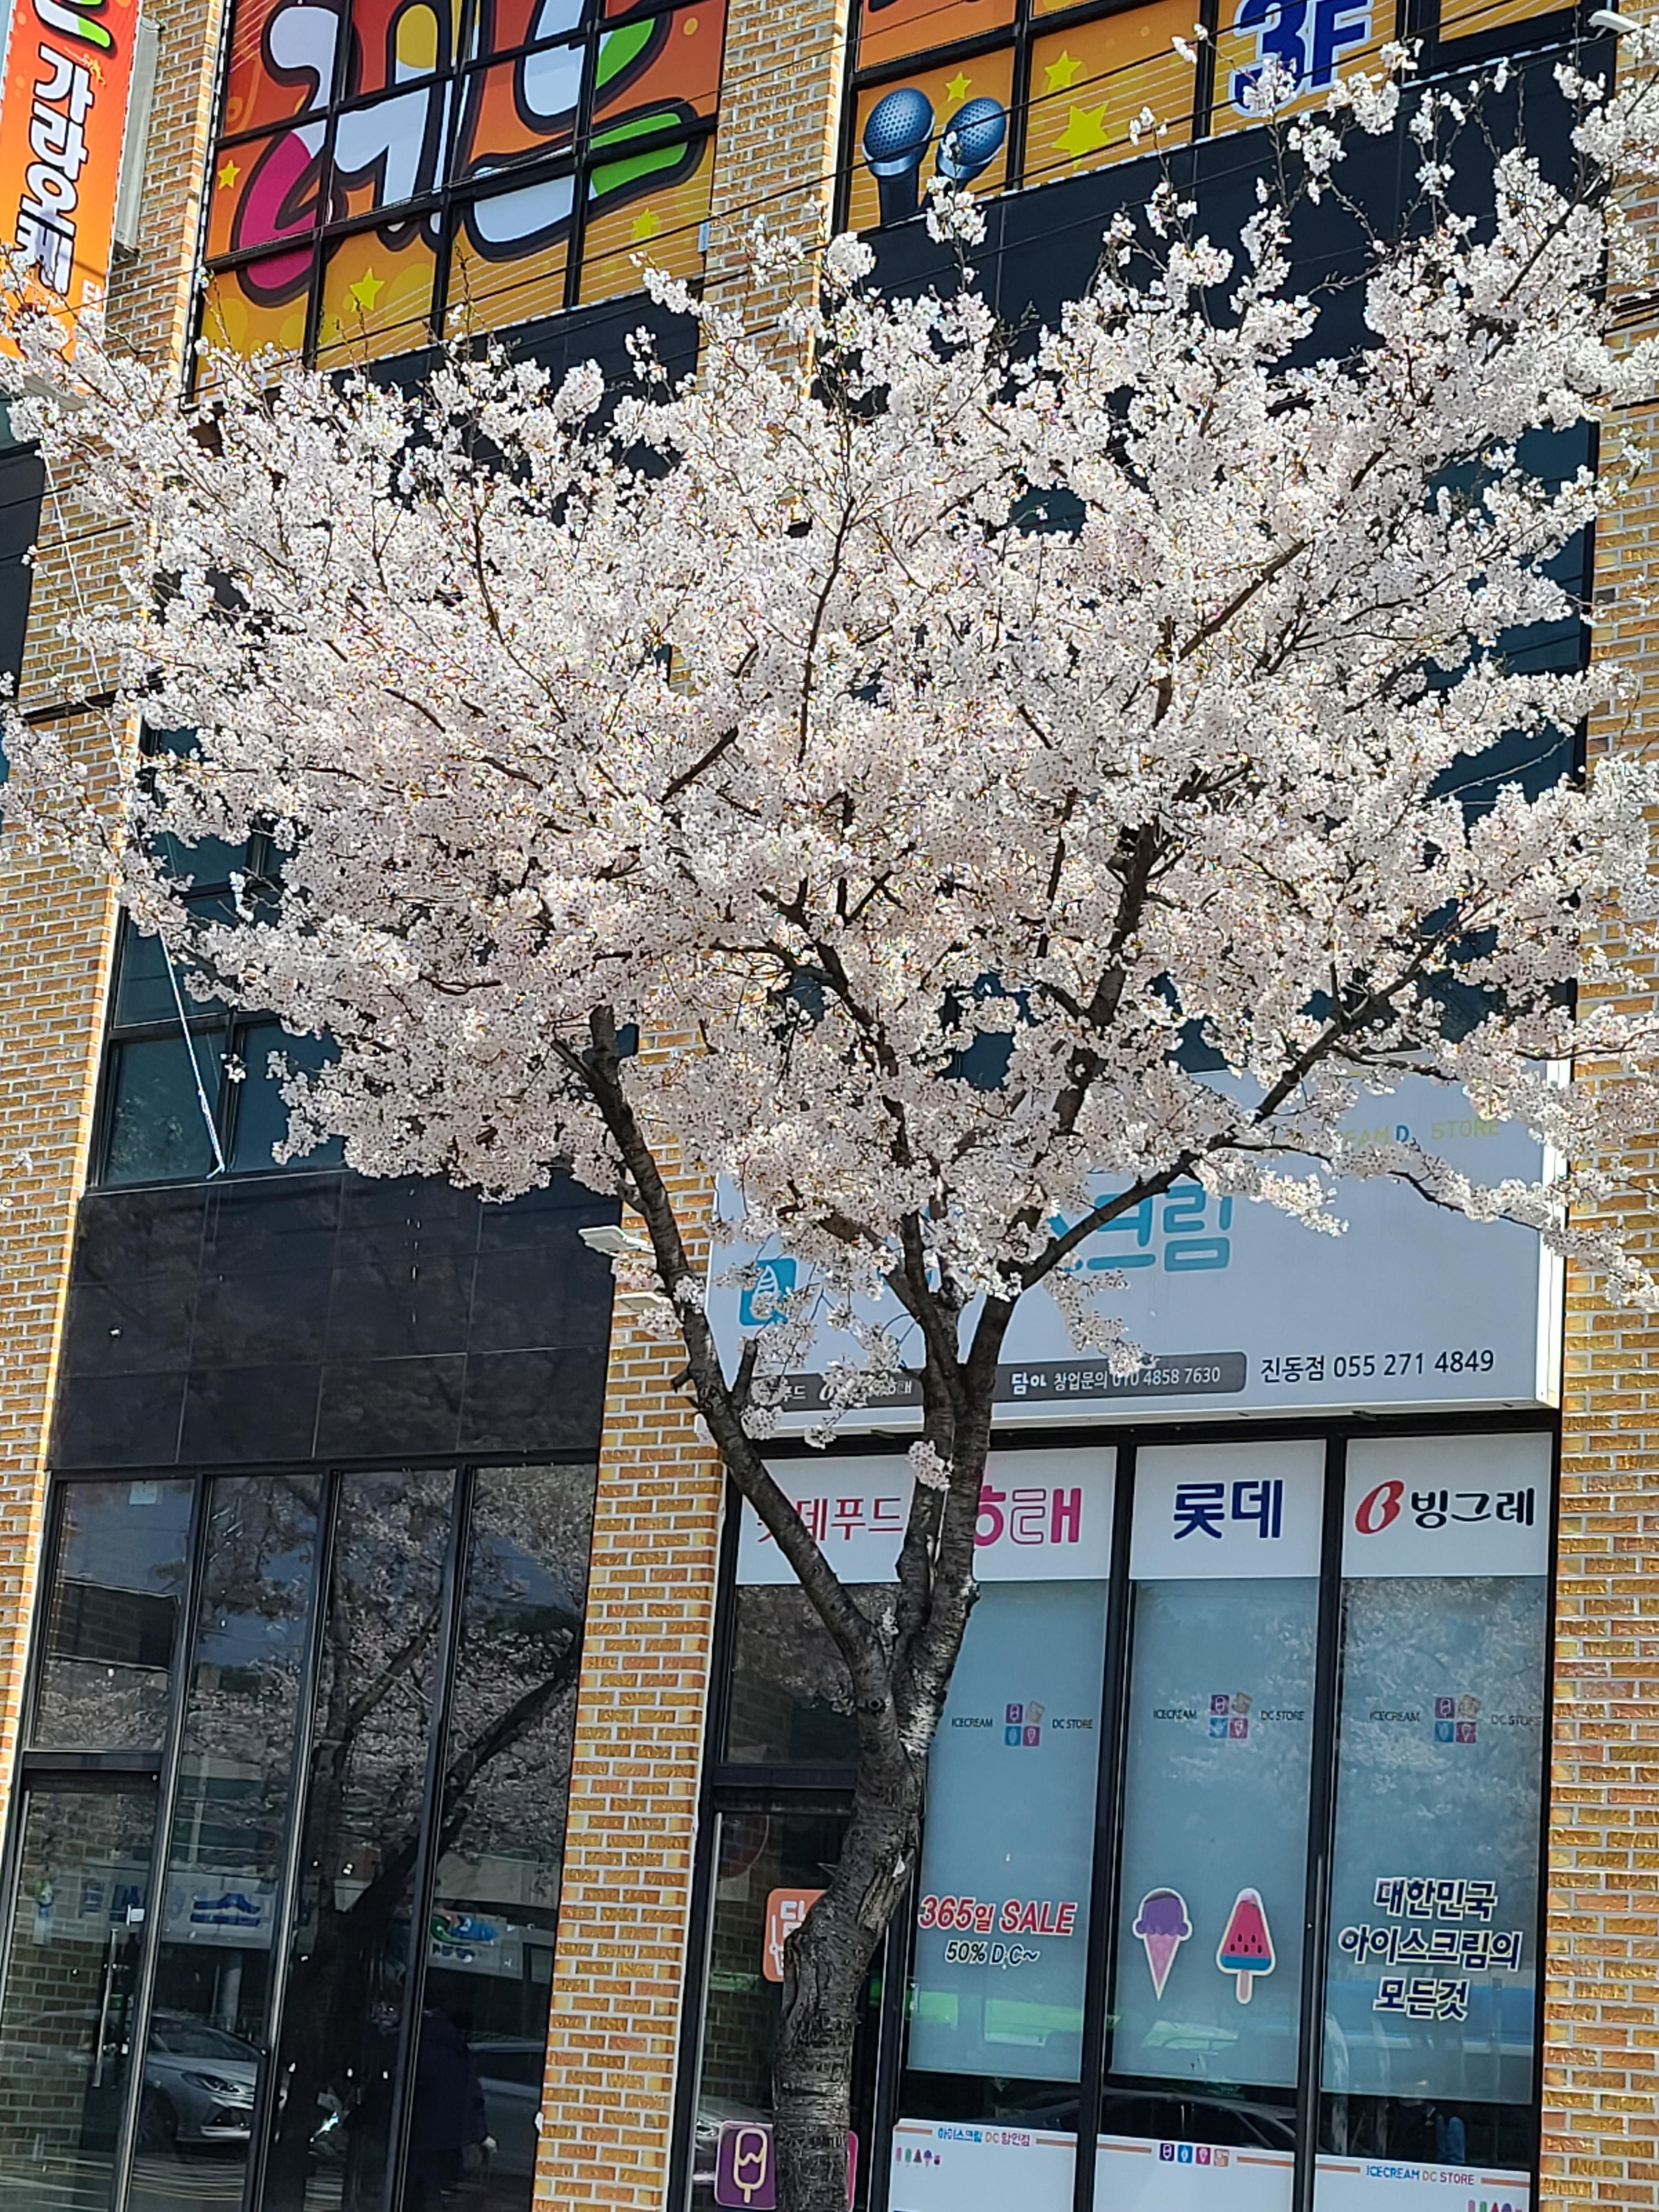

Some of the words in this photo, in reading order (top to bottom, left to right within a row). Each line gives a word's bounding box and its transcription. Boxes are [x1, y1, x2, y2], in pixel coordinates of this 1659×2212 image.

[1229, 0, 1373, 115] 3F
[14, 43, 94, 296] 가라오케
[1431, 1117, 1500, 1140] STORE
[1053, 1370, 1108, 1392] 창업문의
[1142, 1368, 1180, 1386] 4858
[1184, 1366, 1222, 1384] 7630
[1260, 1354, 1325, 1383] 진동점
[1333, 1354, 1376, 1378] 055
[1383, 1353, 1423, 1376] 271
[1434, 1349, 1494, 1373] 4849
[756, 1498, 904, 1543] 데푸드
[1173, 1480, 1284, 1540] 롯데
[1411, 1488, 1535, 1529] 빙그레
[918, 1895, 996, 1934] 365일
[999, 1898, 1078, 1936] SALE
[1374, 1878, 1497, 1921] 대한민국
[945, 1939, 987, 1964] 50%
[1339, 1924, 1523, 1971] 아이스크림의
[1373, 1976, 1469, 2021] 모든것
[937, 2127, 982, 2143] 아이스크림
[1366, 2164, 1420, 2181] ICECREAM
[1422, 2170, 1437, 2183] DC
[1439, 2172, 1475, 2185] STORE
